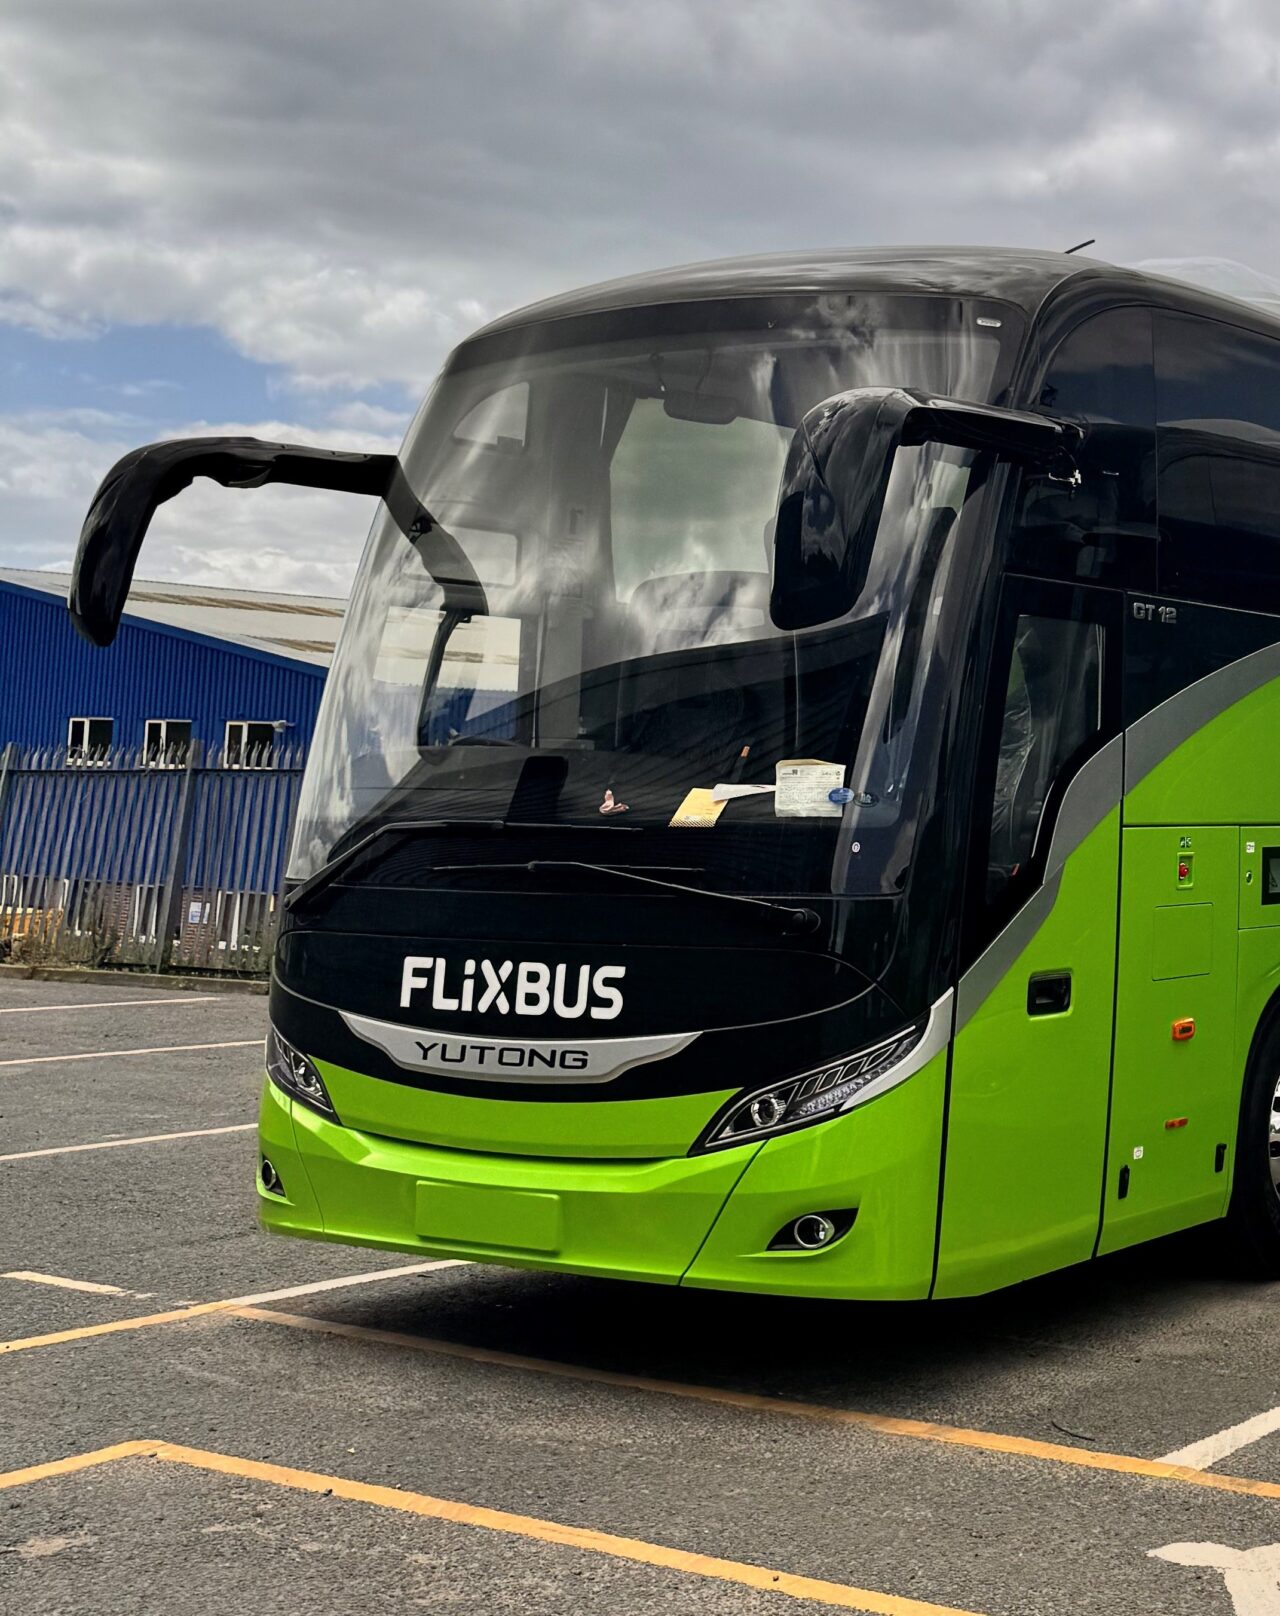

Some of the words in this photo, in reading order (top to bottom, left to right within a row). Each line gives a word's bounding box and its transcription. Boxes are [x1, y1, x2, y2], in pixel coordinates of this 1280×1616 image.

[1133, 602, 1155, 621] GT
[1158, 606, 1176, 624] 12
[400, 956, 626, 1019] FLiXBUS
[414, 1041, 589, 1069] YUTONG
